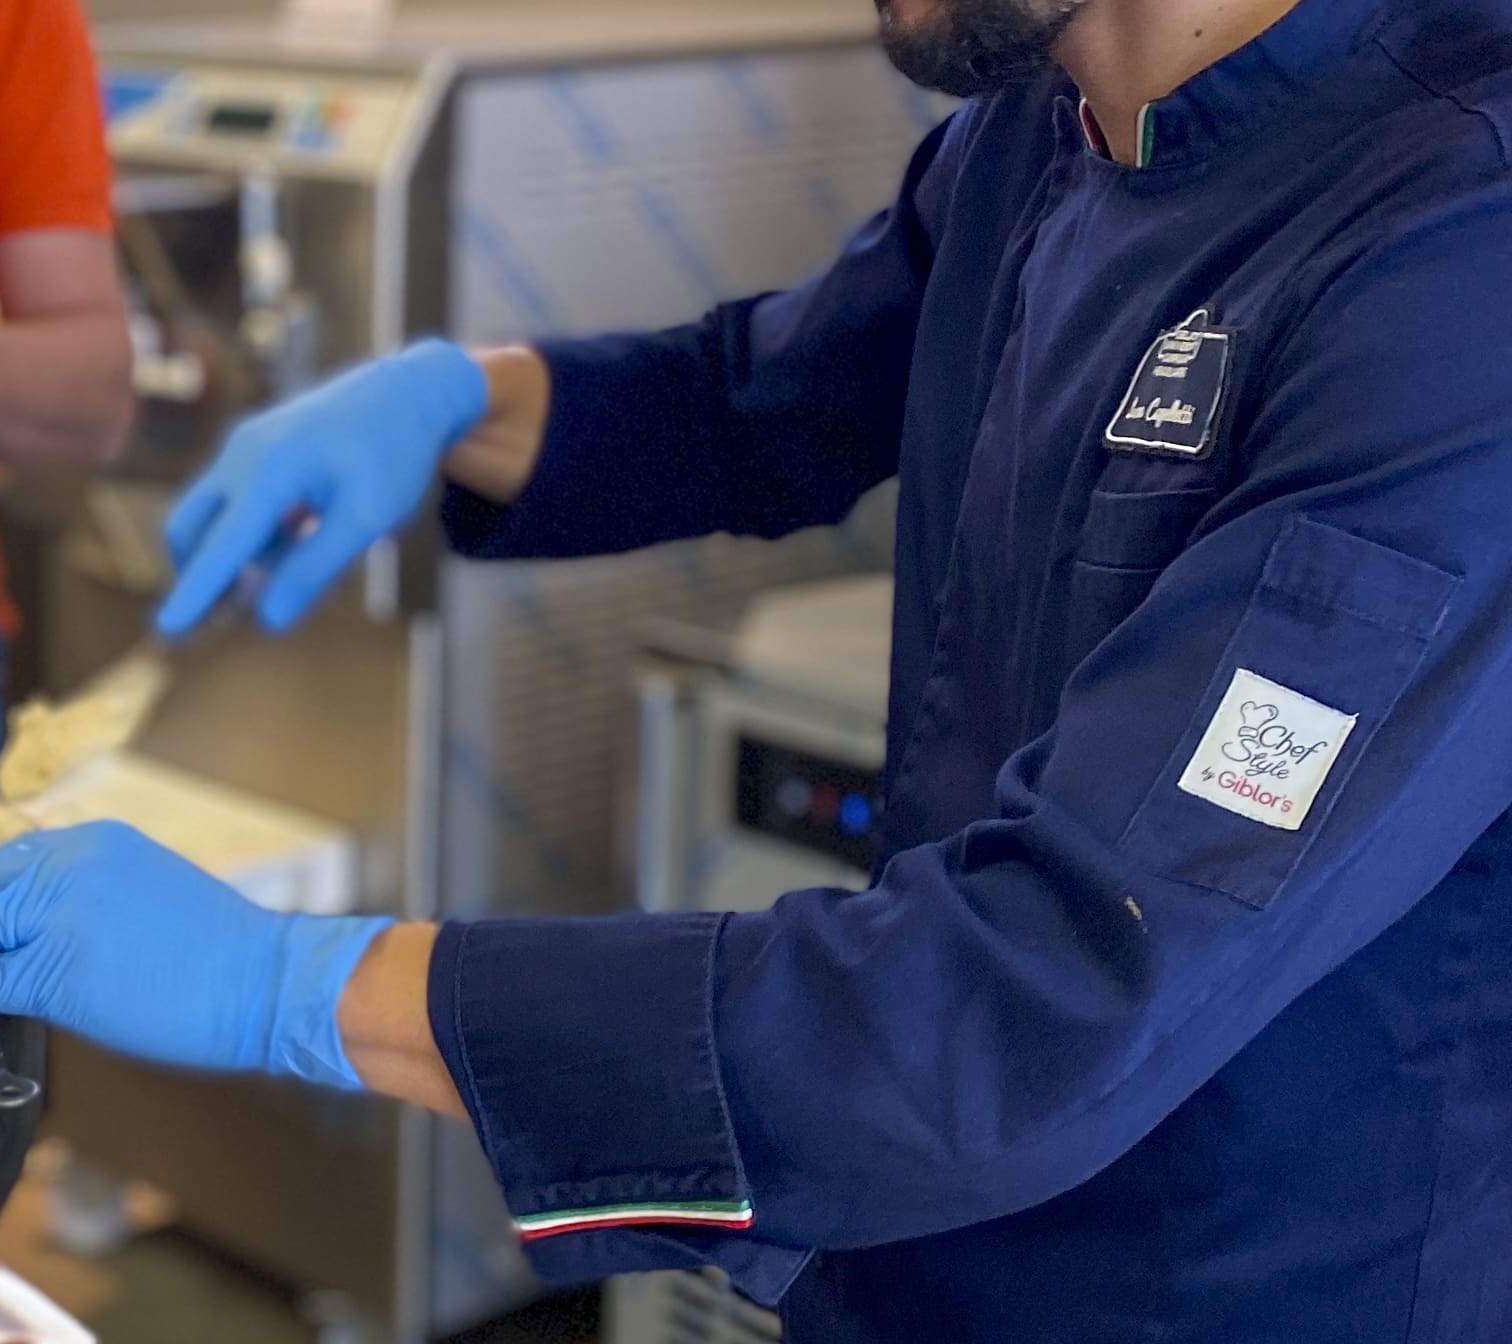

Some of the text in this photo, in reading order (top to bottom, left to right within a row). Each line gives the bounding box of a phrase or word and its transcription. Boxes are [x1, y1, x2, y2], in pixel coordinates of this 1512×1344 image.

[1221, 738, 1291, 780] Style
[1259, 725, 1328, 765] Chef
[1201, 766, 1294, 813] by Giblor's
